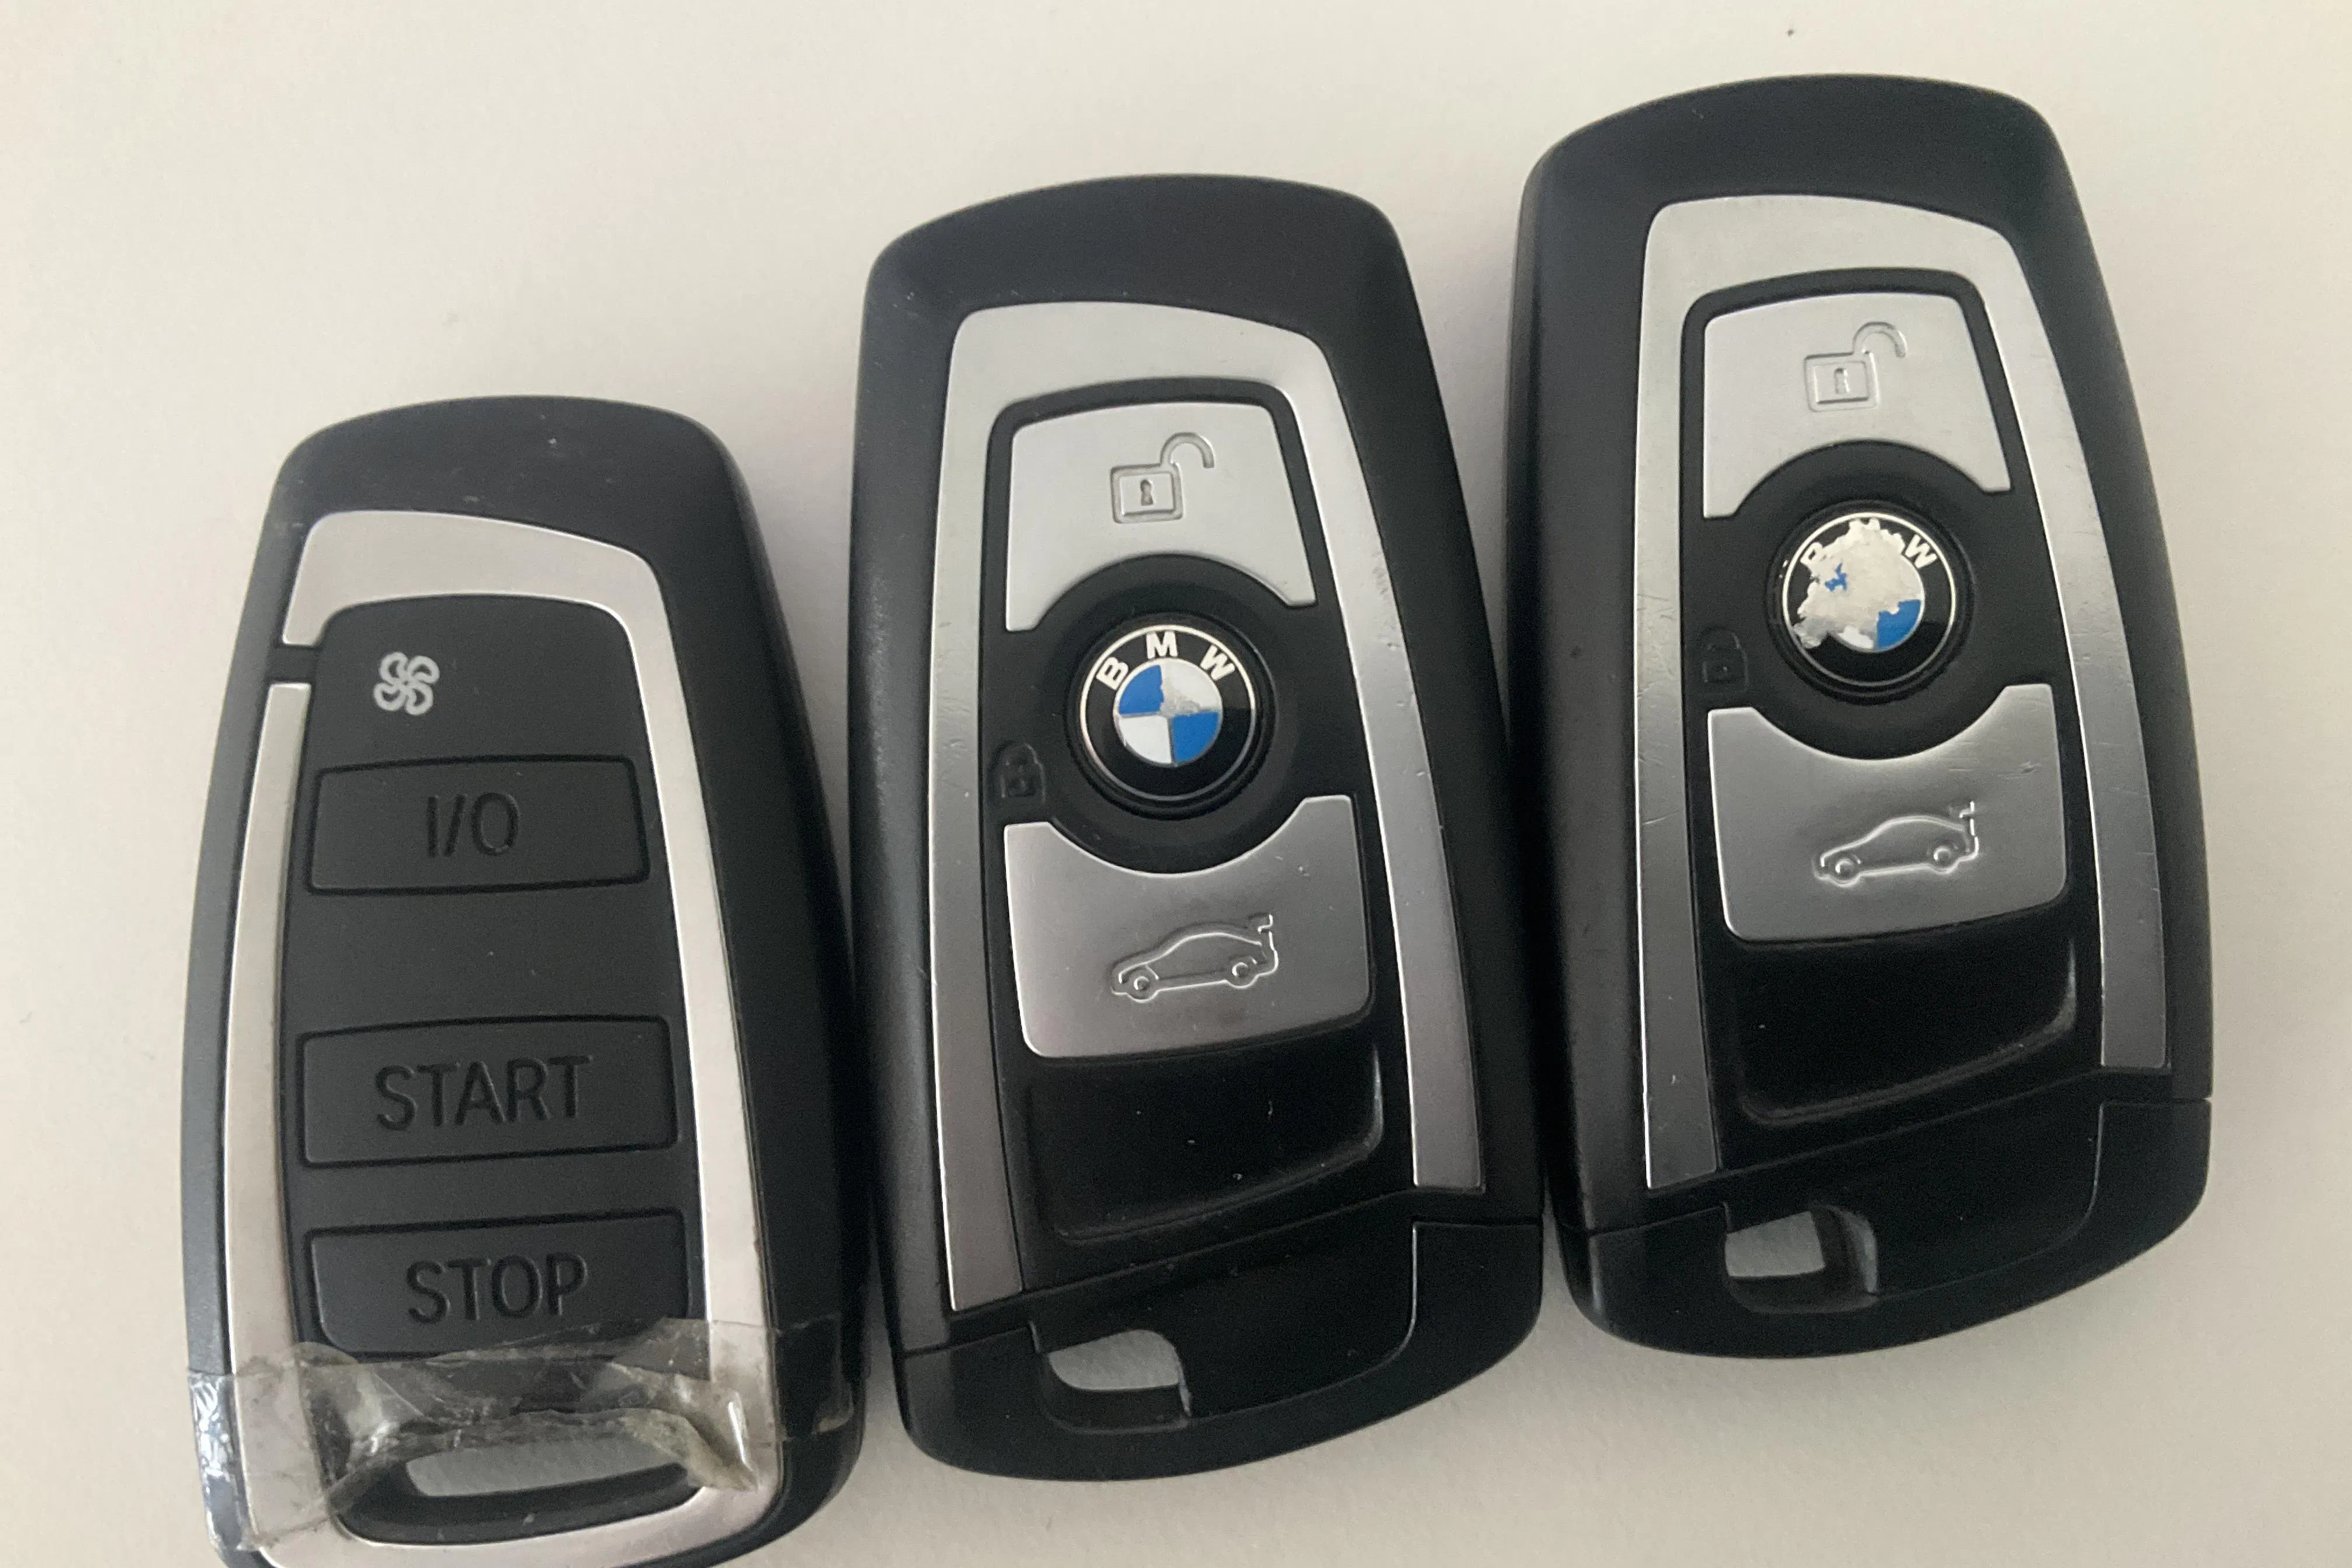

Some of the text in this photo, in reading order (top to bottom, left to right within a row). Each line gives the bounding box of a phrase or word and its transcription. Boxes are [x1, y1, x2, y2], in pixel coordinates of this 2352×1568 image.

[1096, 631, 1236, 691] BMW
[427, 792, 520, 858] I/O
[375, 1055, 593, 1130] START
[407, 1252, 587, 1324] STOP
